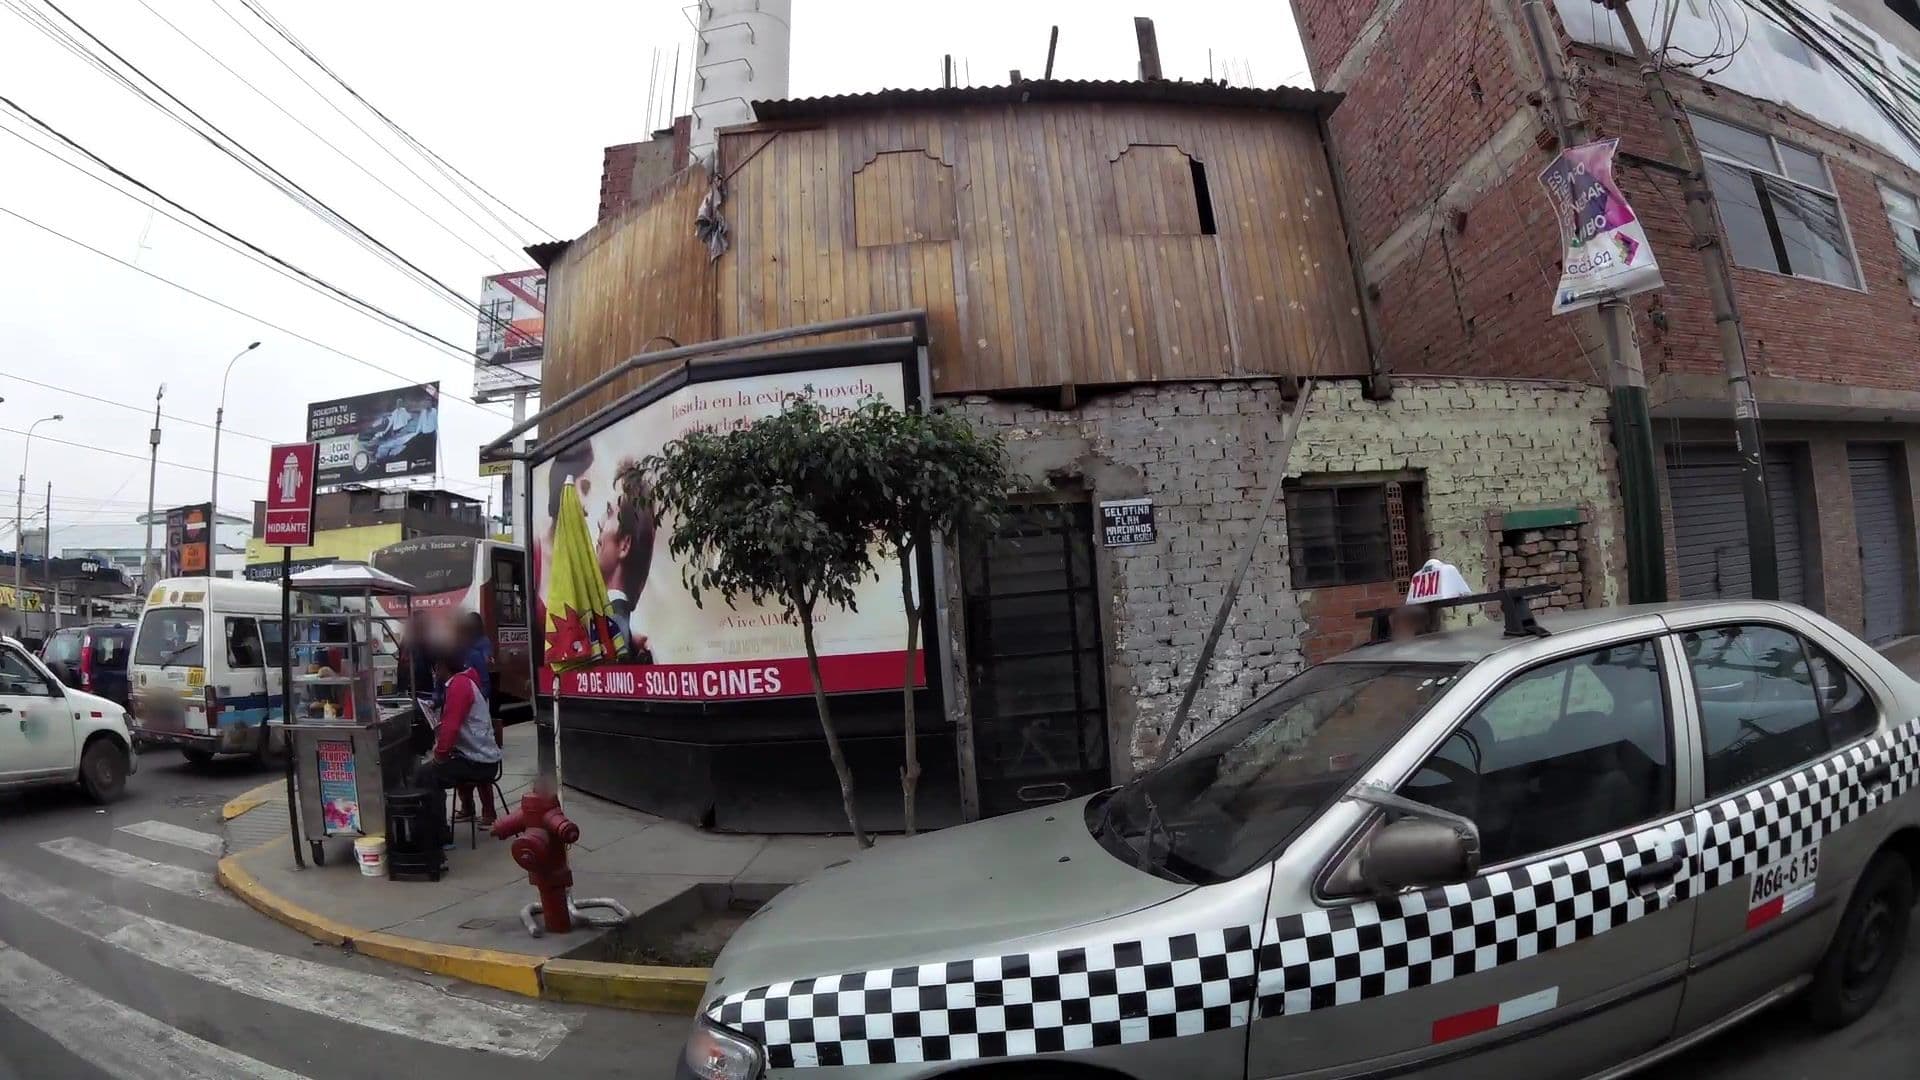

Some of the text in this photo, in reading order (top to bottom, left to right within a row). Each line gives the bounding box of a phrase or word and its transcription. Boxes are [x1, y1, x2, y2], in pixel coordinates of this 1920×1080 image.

[1547, 170, 1563, 191] ES
[712, 396, 733, 408] en
[737, 391, 751, 406] la
[818, 379, 873, 400] novela
[339, 405, 349, 413] TU
[311, 412, 357, 430] REMISSE
[1104, 505, 1150, 518] GELATINA
[1115, 515, 1140, 526] FLAN
[267, 522, 307, 533] HIDRANTE
[1106, 523, 1152, 537] MARCIANOS
[1107, 534, 1131, 544] LECHE
[81, 561, 99, 573] GNV
[1412, 570, 1440, 599] TAXI
[576, 672, 588, 692] 29
[590, 672, 602, 693] DE
[604, 671, 634, 694] JUNIO
[645, 671, 678, 696] SOLO
[682, 671, 699, 697] EN
[703, 667, 781, 697] CINES
